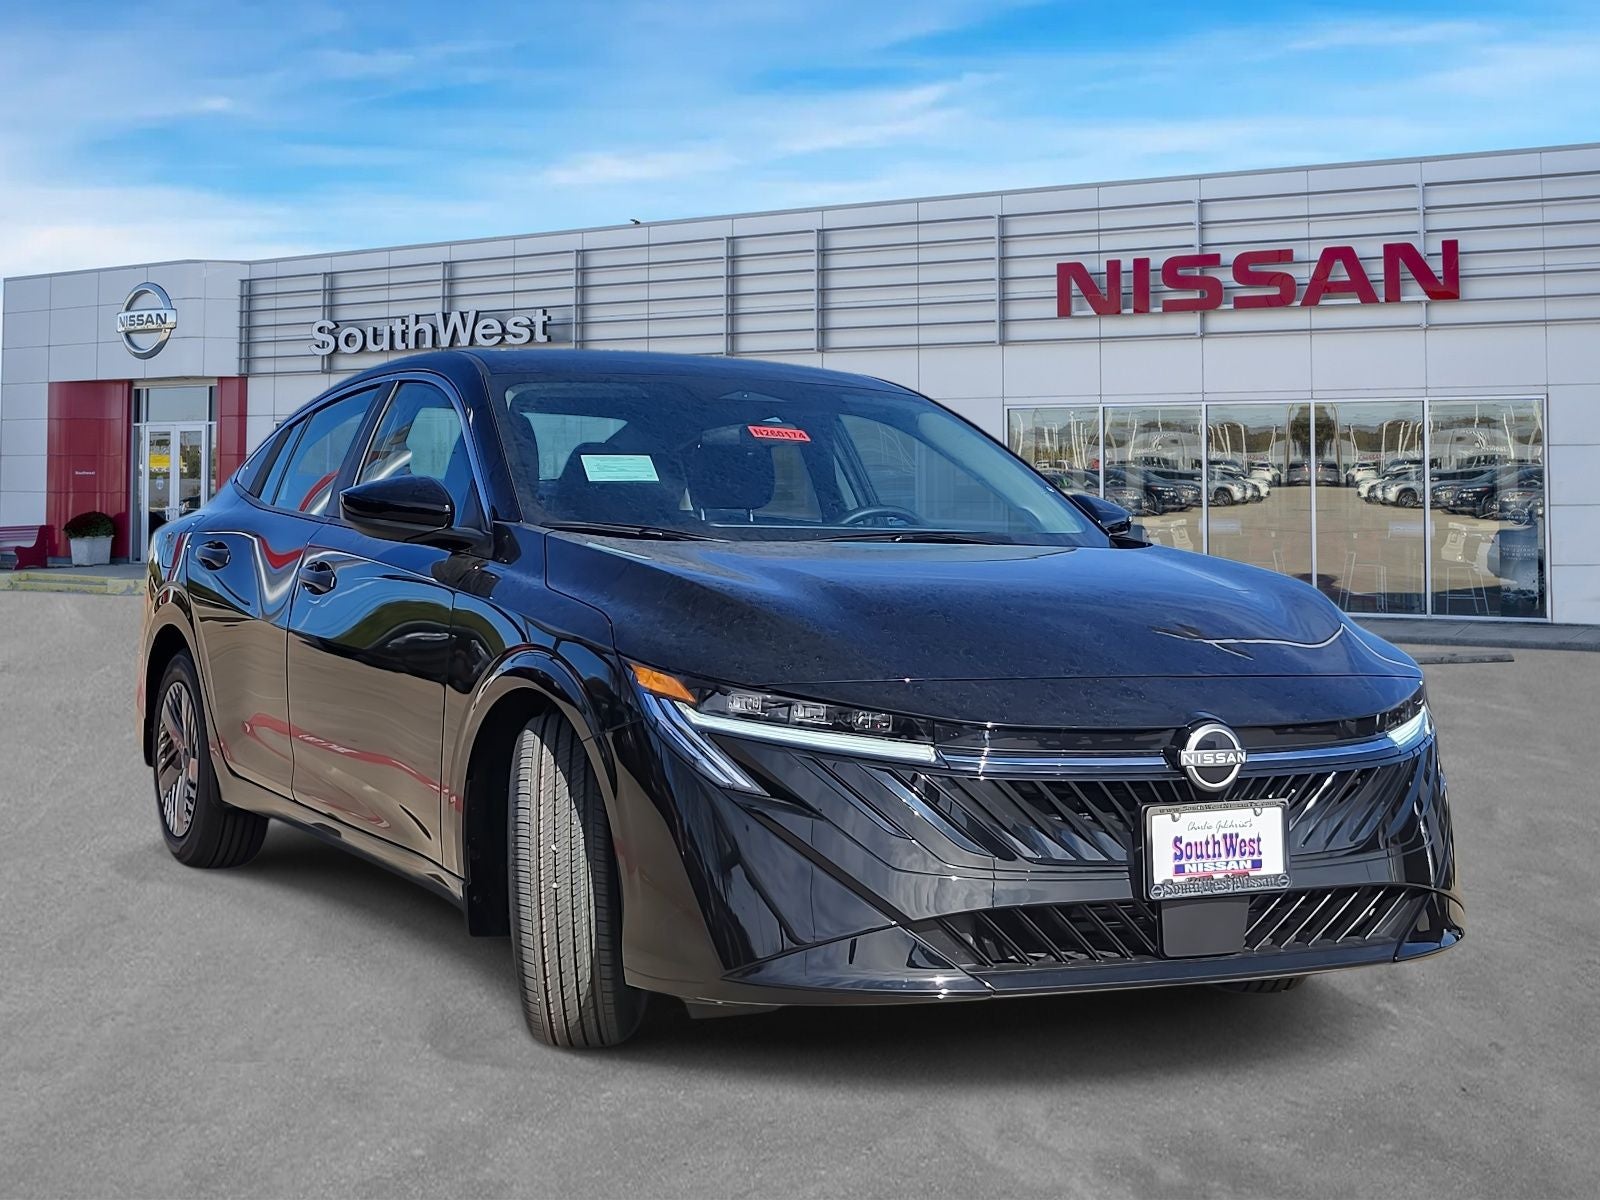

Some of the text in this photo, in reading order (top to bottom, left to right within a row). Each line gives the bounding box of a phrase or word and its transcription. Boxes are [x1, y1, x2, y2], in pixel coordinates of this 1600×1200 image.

[1057, 239, 1460, 317] NISSAN
[119, 312, 167, 328] NISSAN
[310, 308, 550, 356] SouthWest
[1182, 752, 1247, 766] NISSAN
[1172, 832, 1262, 862] SouthWest
[1184, 860, 1251, 874] NISSAN
